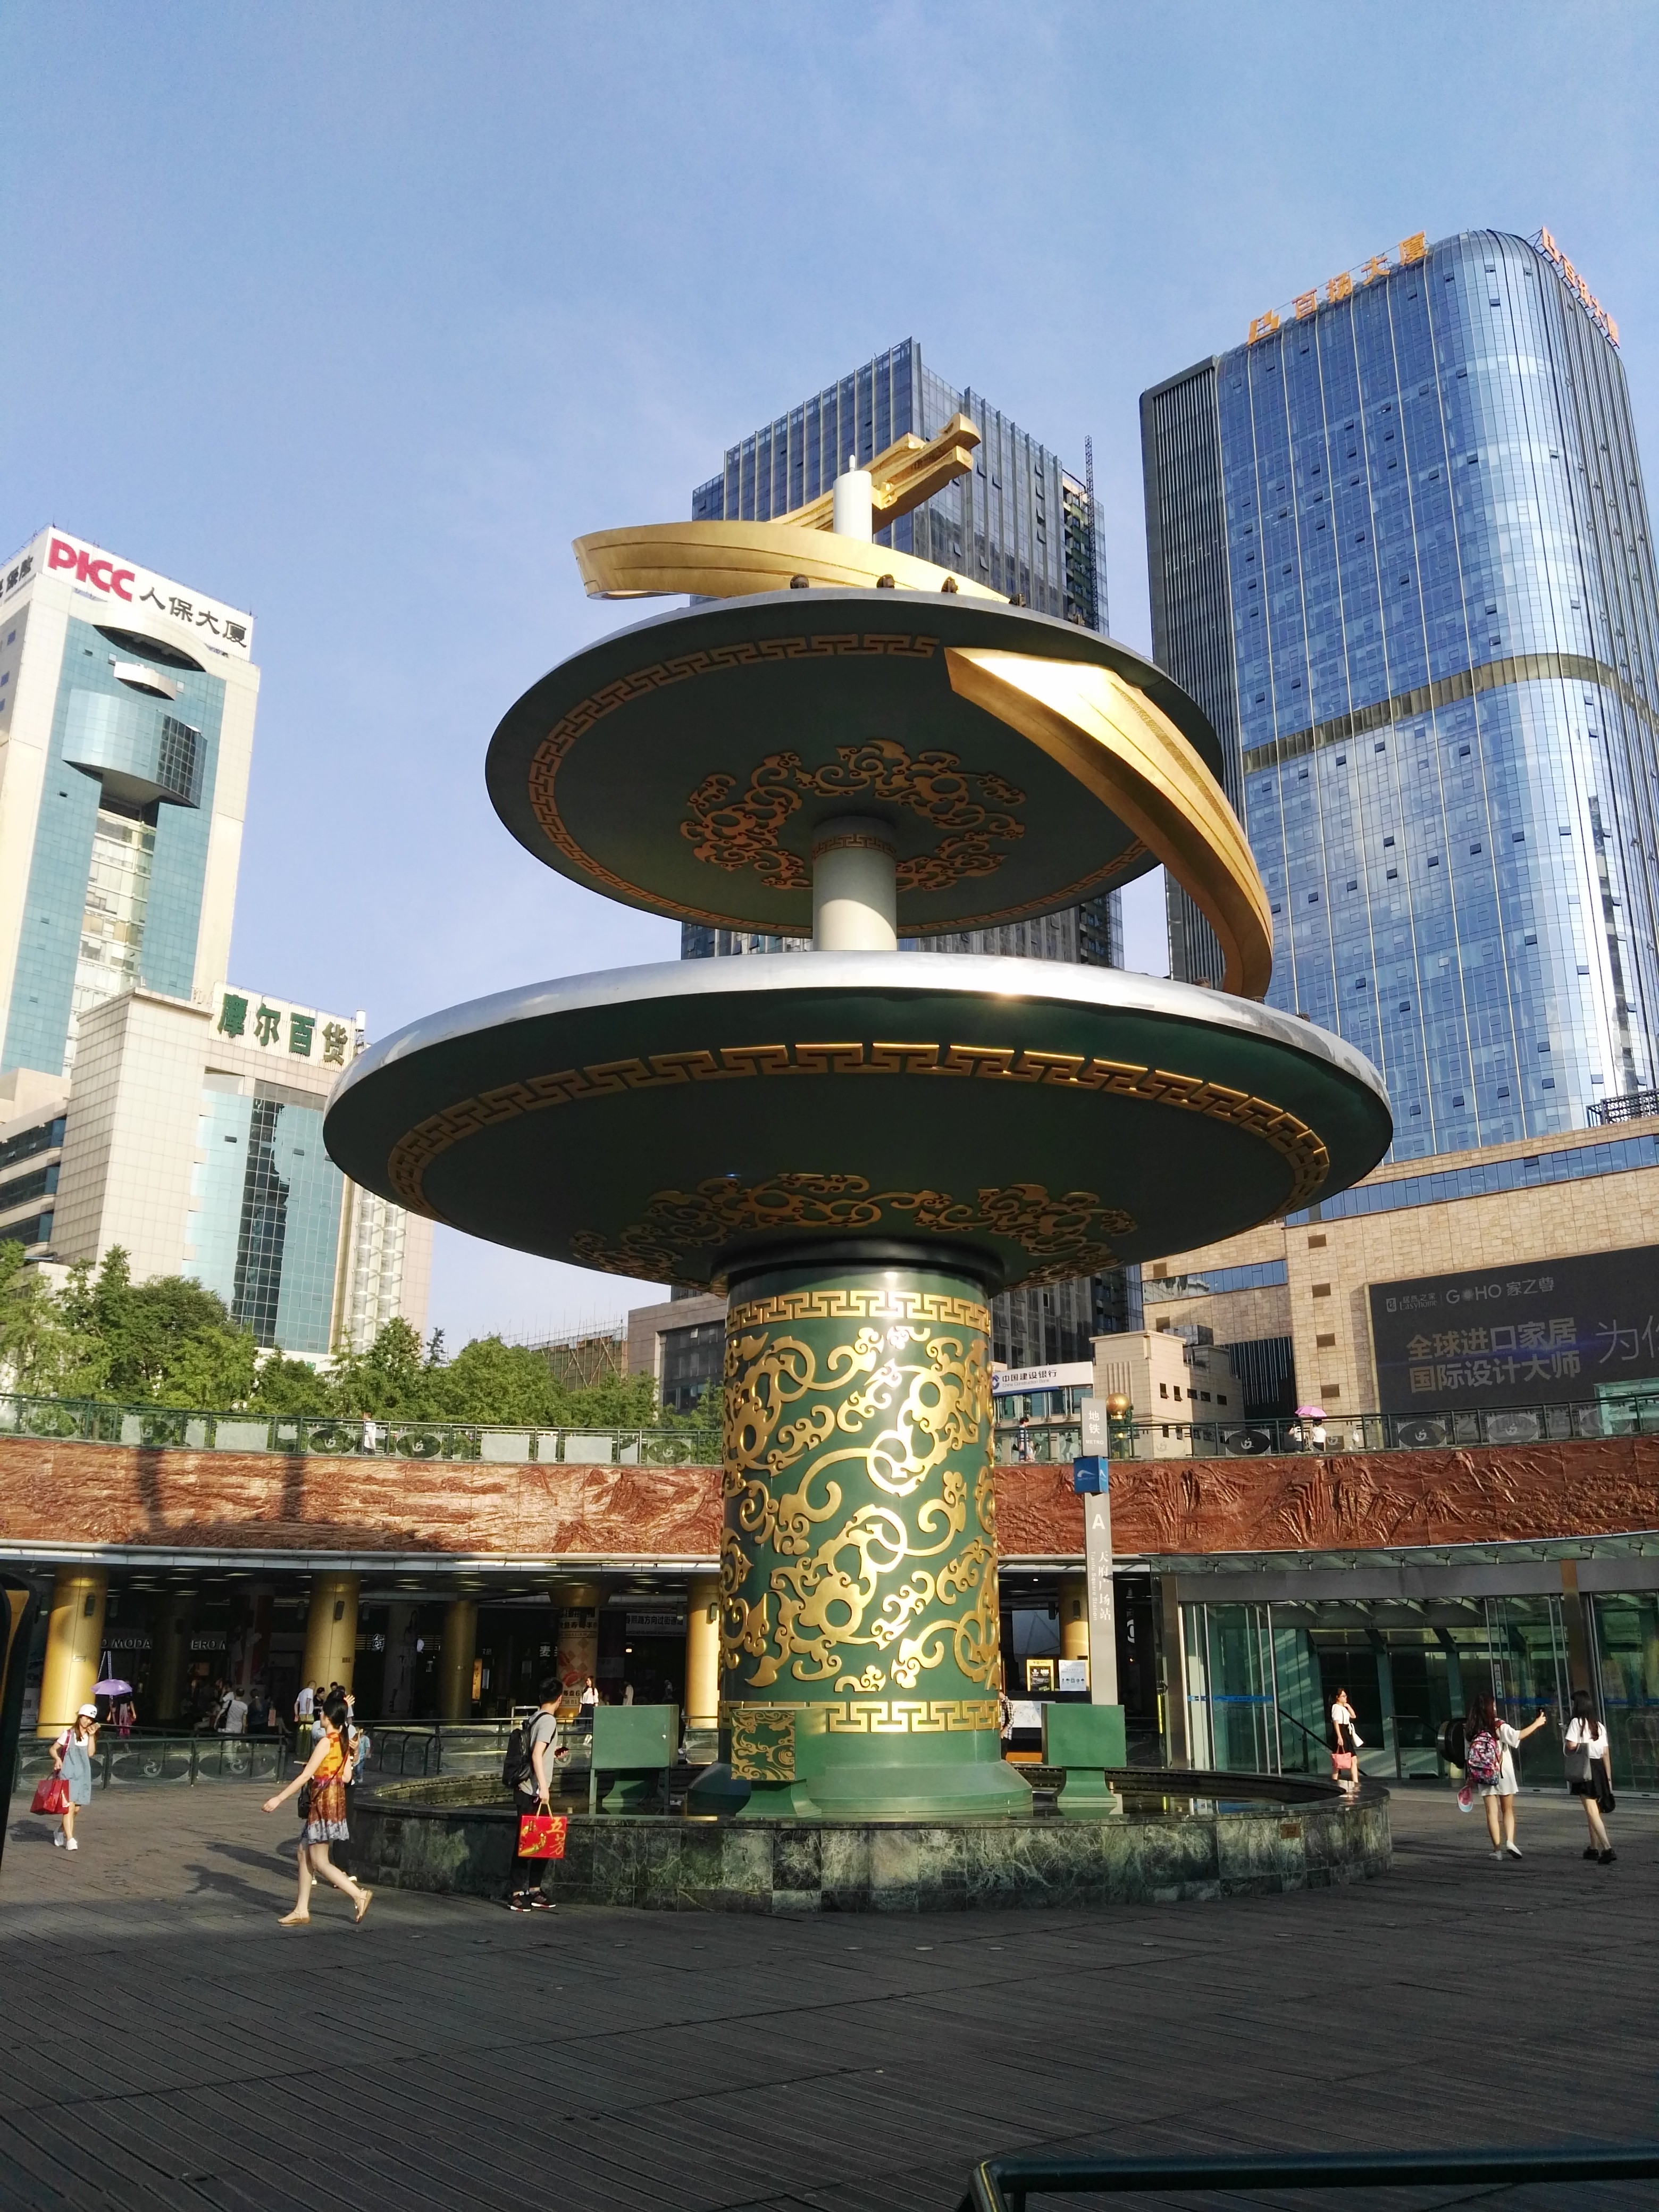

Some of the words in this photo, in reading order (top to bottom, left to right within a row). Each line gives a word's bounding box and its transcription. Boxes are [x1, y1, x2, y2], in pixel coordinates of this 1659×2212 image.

[47, 537, 135, 602] PICC
[140, 586, 247, 648] 人保大厦
[217, 992, 348, 1066] 摩尔百货
[1406, 1317, 1577, 1361] 全球进口家居
[1002, 1369, 1058, 1382] 中国建设银行
[1409, 1349, 1581, 1393] 国际设计大师
[1088, 1410, 1100, 1434] 地铁
[1092, 1513, 1105, 1530] A
[1098, 1551, 1111, 1621] 天府广场站
[112, 1638, 151, 1648] MODA
[191, 1639, 216, 1650] ERO
